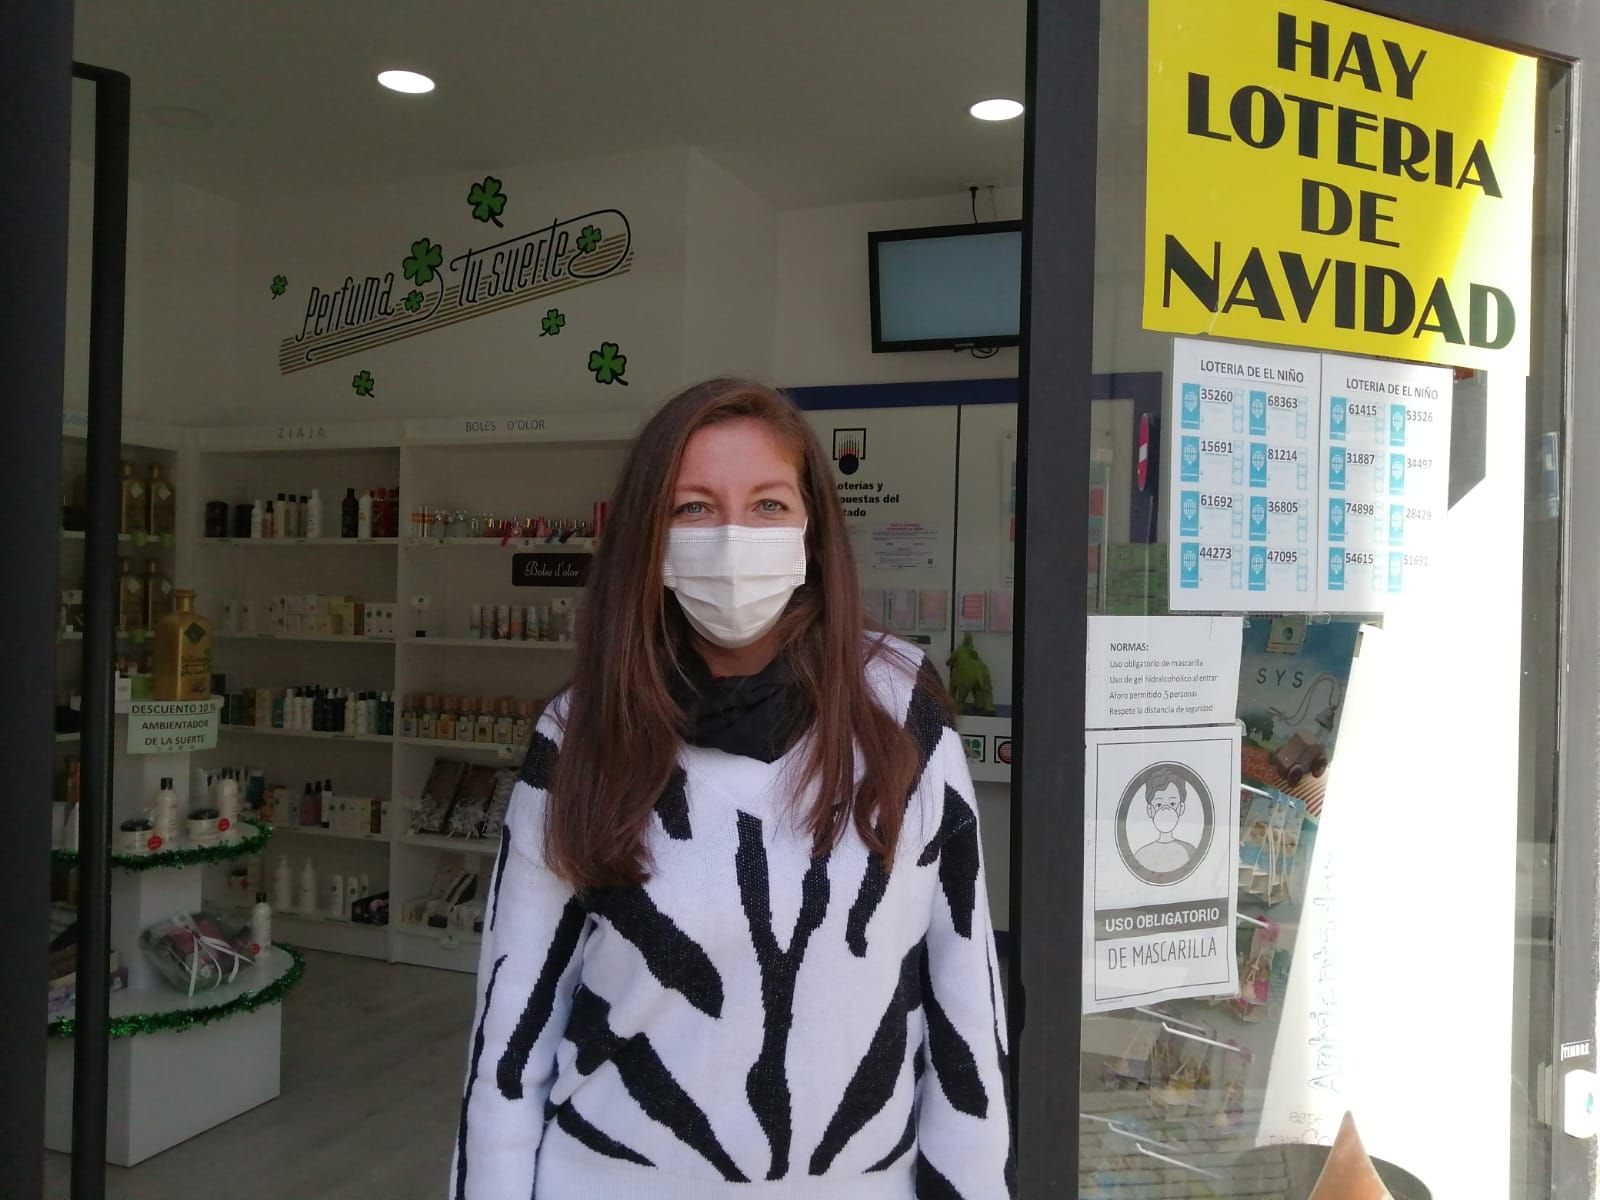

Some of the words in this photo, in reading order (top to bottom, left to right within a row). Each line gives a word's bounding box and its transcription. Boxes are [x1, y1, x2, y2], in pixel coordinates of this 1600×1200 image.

[1277, 12, 1428, 100] HAY
[1186, 72, 1502, 198] LOTERIA
[1301, 178, 1400, 248] DE
[1162, 234, 1516, 350] NAVIDAD
[295, 273, 396, 342] Perfuma
[1200, 359, 1244, 376] LOTERIA
[1247, 365, 1261, 378] DE
[1263, 366, 1275, 380] EL
[1278, 368, 1304, 382] NIÑO
[1200, 389, 1233, 402] 35260
[1346, 378, 1386, 394] LOTERIA
[1388, 382, 1400, 396] DE
[1402, 384, 1412, 396] EL
[1414, 384, 1438, 400] NIÑO
[1268, 395, 1298, 408] 68363
[1348, 404, 1377, 416] 61415
[1406, 410, 1433, 422] 53526
[465, 420, 496, 432] BOLES
[507, 419, 545, 432] D'OLOR
[1200, 440, 1233, 454] 15691
[1268, 448, 1297, 461] 81214
[1346, 452, 1375, 465] 31887
[1406, 458, 1432, 470] 34497
[838, 481, 874, 490] oterías
[877, 483, 883, 492] y
[883, 494, 899, 503] del
[1200, 495, 1232, 508] 61692
[844, 508, 866, 516] tado
[1268, 501, 1298, 514] 36805
[1346, 502, 1374, 516] 74898
[1200, 547, 1232, 560] 44273
[1267, 551, 1297, 563] 47095
[1345, 552, 1374, 565] 54615
[524, 560, 552, 577] Boles
[1110, 642, 1149, 652] NORMAS:
[1124, 660, 1160, 669] obligatorio
[1134, 676, 1144, 684] gel
[1130, 691, 1162, 700] permitido
[132, 704, 196, 714] DESCUENTO
[1144, 706, 1174, 714] distancia
[1186, 705, 1212, 713] seguridad
[142, 720, 208, 730] AMBIENTADOR
[145, 738, 158, 746] DE
[161, 736, 172, 744] LA
[175, 735, 205, 744] SUERTE
[1105, 917, 1133, 932] USO
[1136, 908, 1220, 928] OBLIGATORIO
[1108, 948, 1127, 970] DE
[1132, 936, 1216, 967] MASCARILLA
